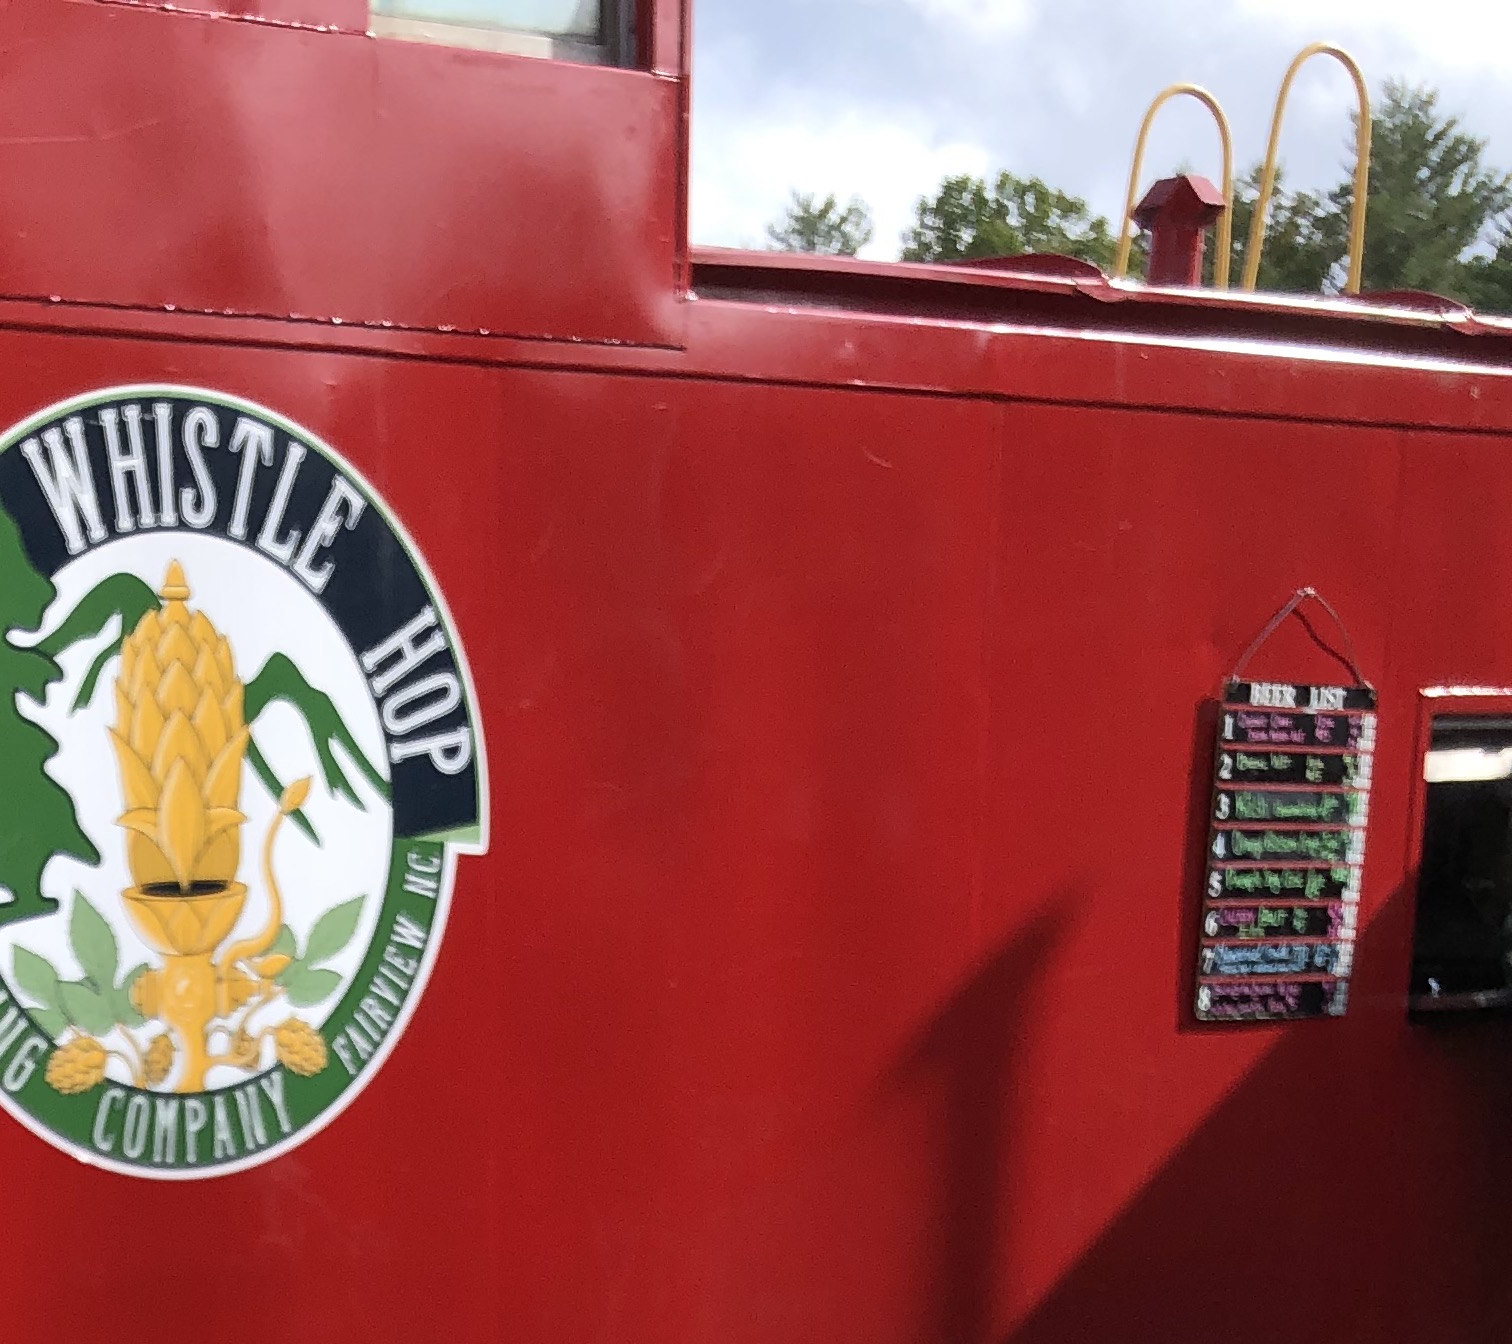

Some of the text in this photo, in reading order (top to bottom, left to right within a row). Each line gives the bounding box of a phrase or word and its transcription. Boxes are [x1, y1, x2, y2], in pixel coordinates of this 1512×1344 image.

[19, 402, 473, 775] WHISTLE HOP
[331, 850, 443, 1077] FAIRVIEW NC
[92, 1071, 291, 1164] COMPANY
